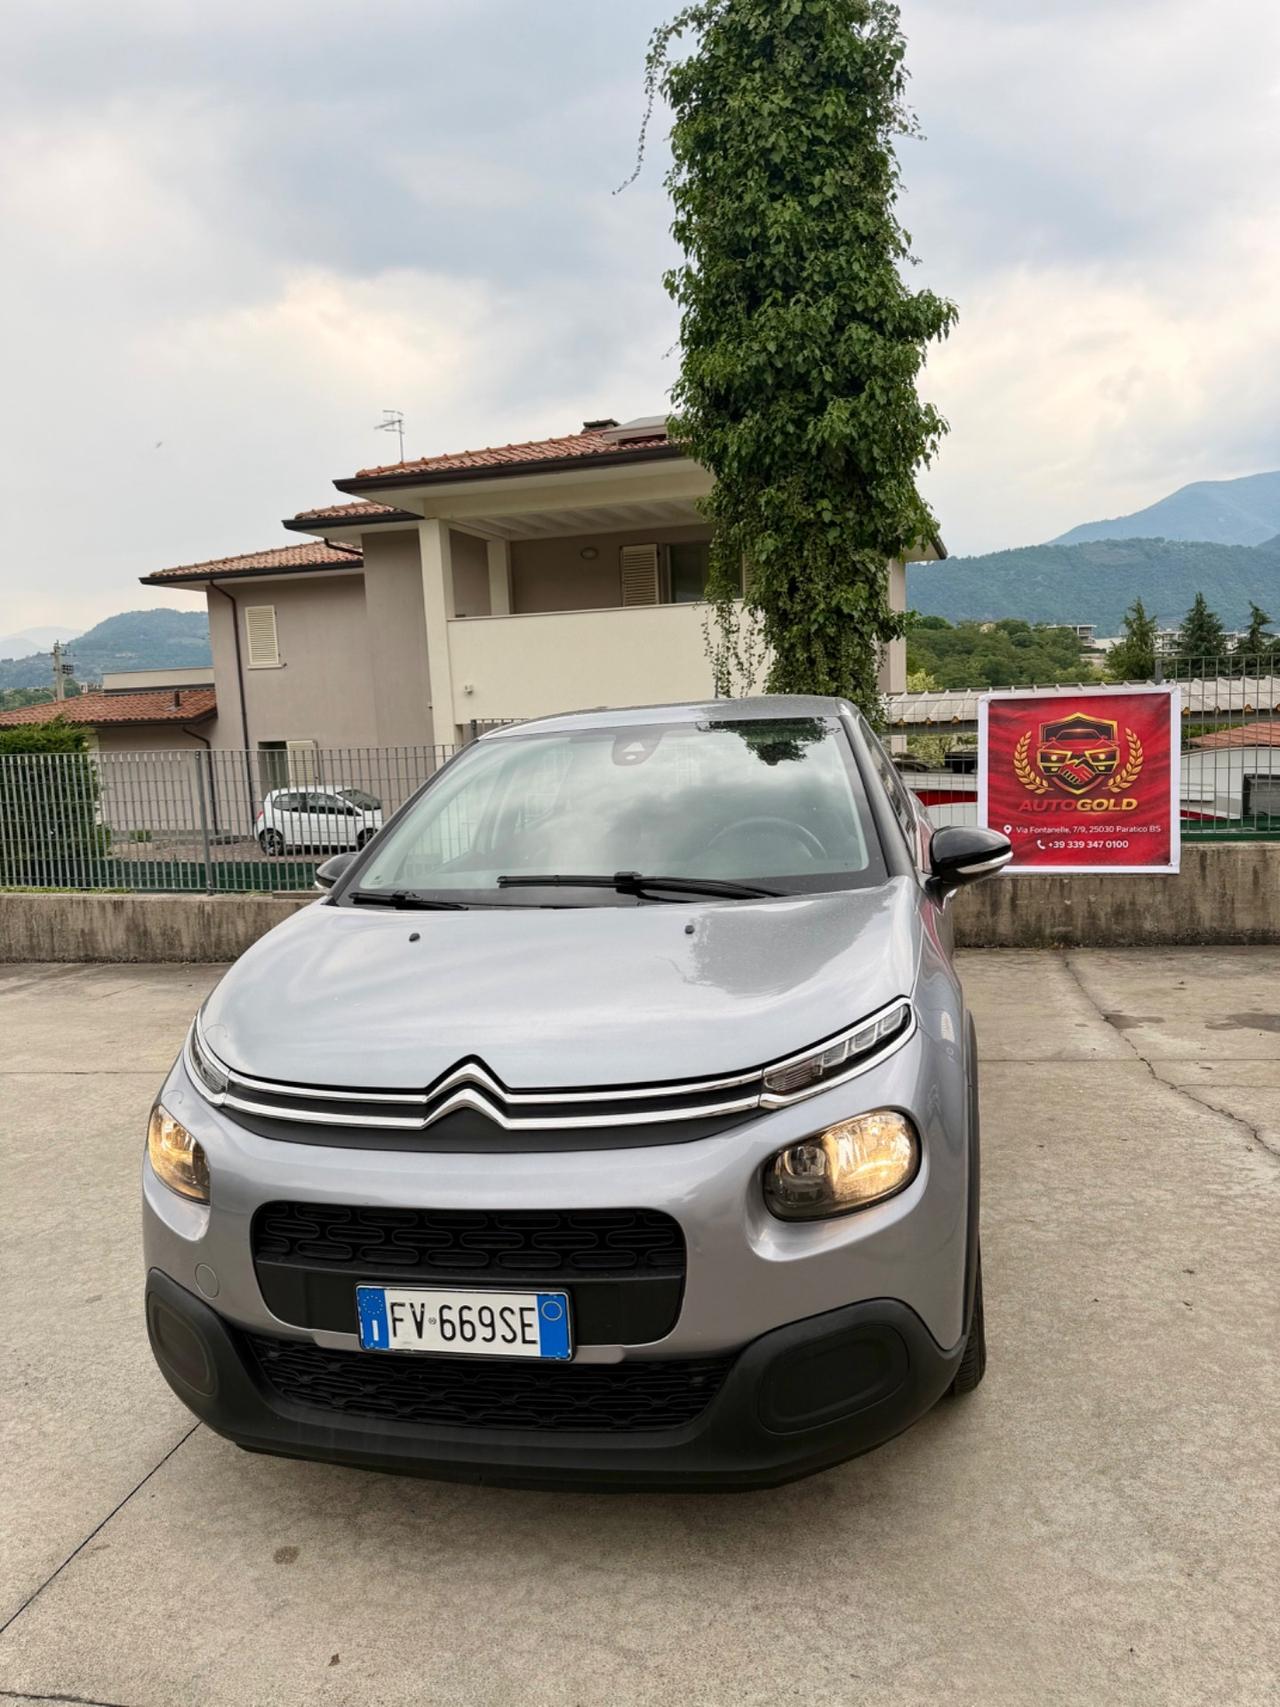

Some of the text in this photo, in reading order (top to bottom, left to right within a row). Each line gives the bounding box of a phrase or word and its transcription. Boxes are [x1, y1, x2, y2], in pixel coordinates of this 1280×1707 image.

[1018, 798, 1138, 812] AUTOGOLD
[1016, 826, 1029, 834] Via
[1073, 826, 1088, 834] 7/9,
[1149, 825, 1161, 833] BS
[1048, 840, 1129, 849] +39 339 347 0100
